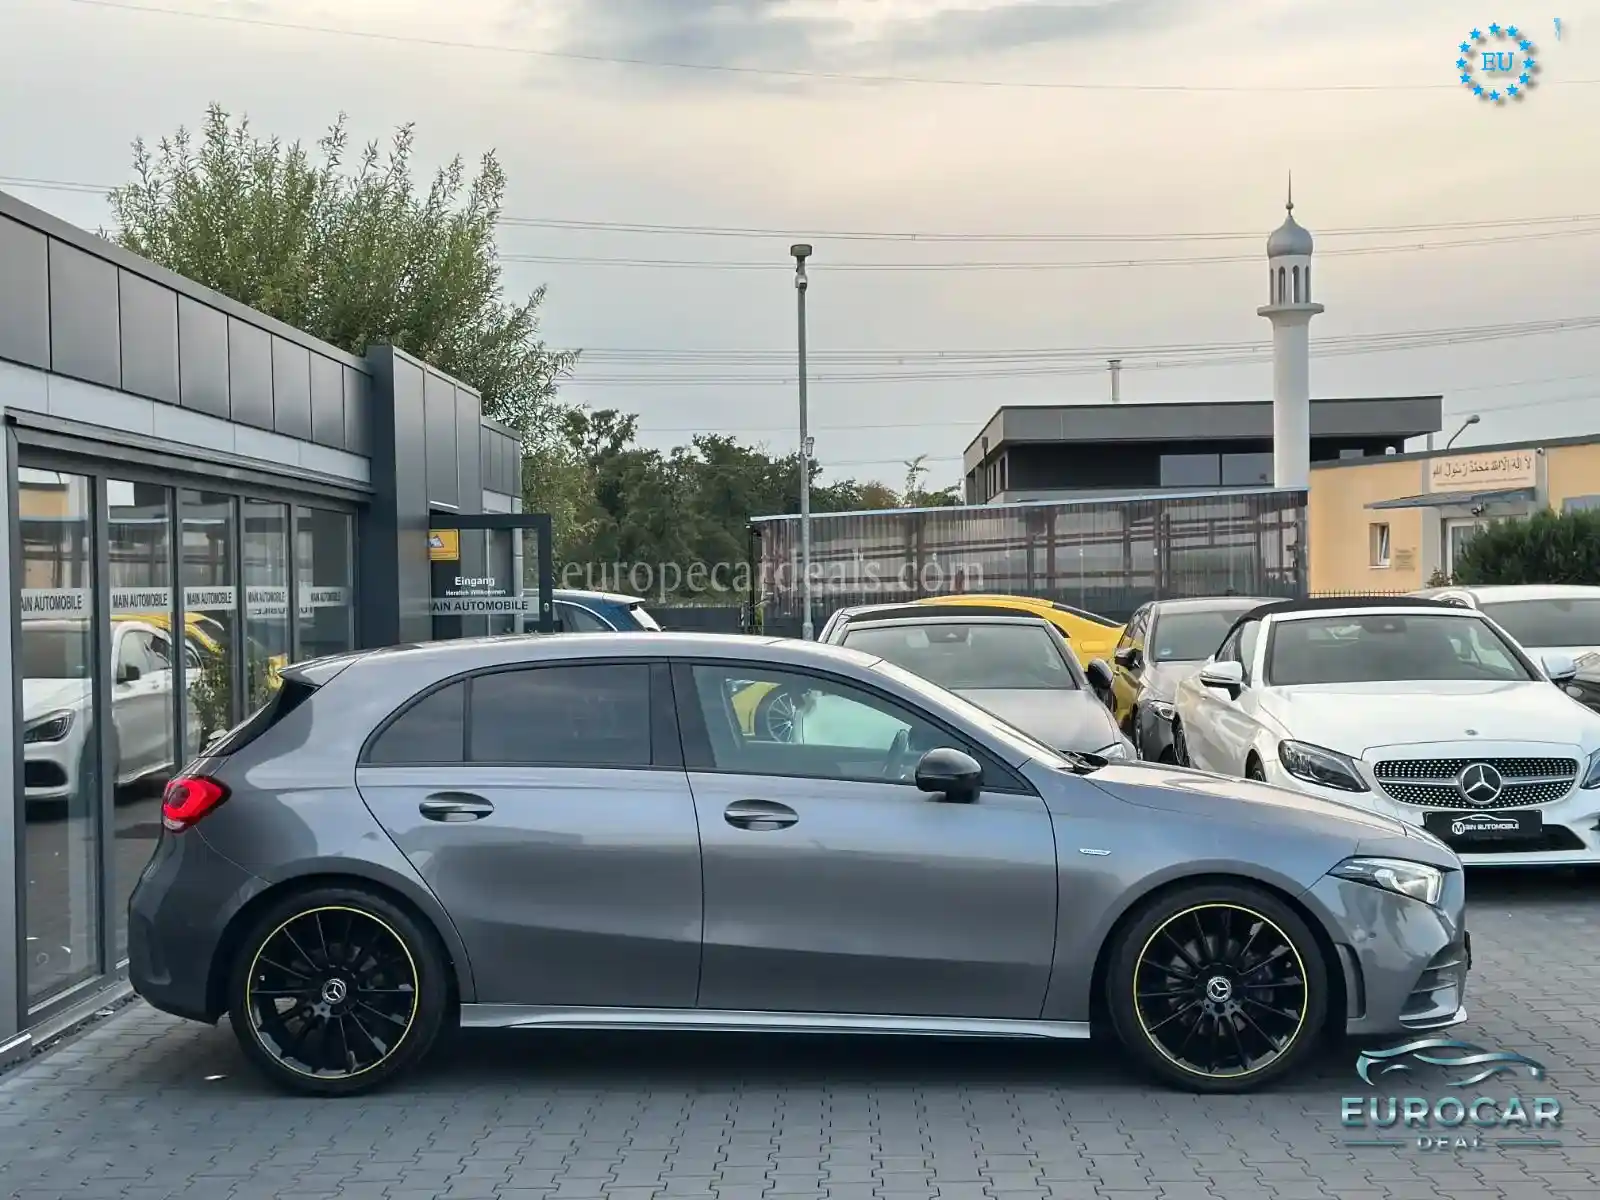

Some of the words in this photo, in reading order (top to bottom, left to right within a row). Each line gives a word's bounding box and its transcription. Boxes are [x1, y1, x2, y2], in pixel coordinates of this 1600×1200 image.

[454, 576, 496, 587] Eingang
[20, 596, 33, 612] AIN
[34, 594, 82, 611] AUTOMOBILE
[112, 593, 129, 608] MAIN
[129, 592, 168, 608] AUTOMOBILE
[187, 593, 201, 605] MAIN
[201, 591, 232, 605] AUTOMOBILE
[432, 601, 451, 611] AIN
[453, 600, 529, 611] AUTOMOBILE
